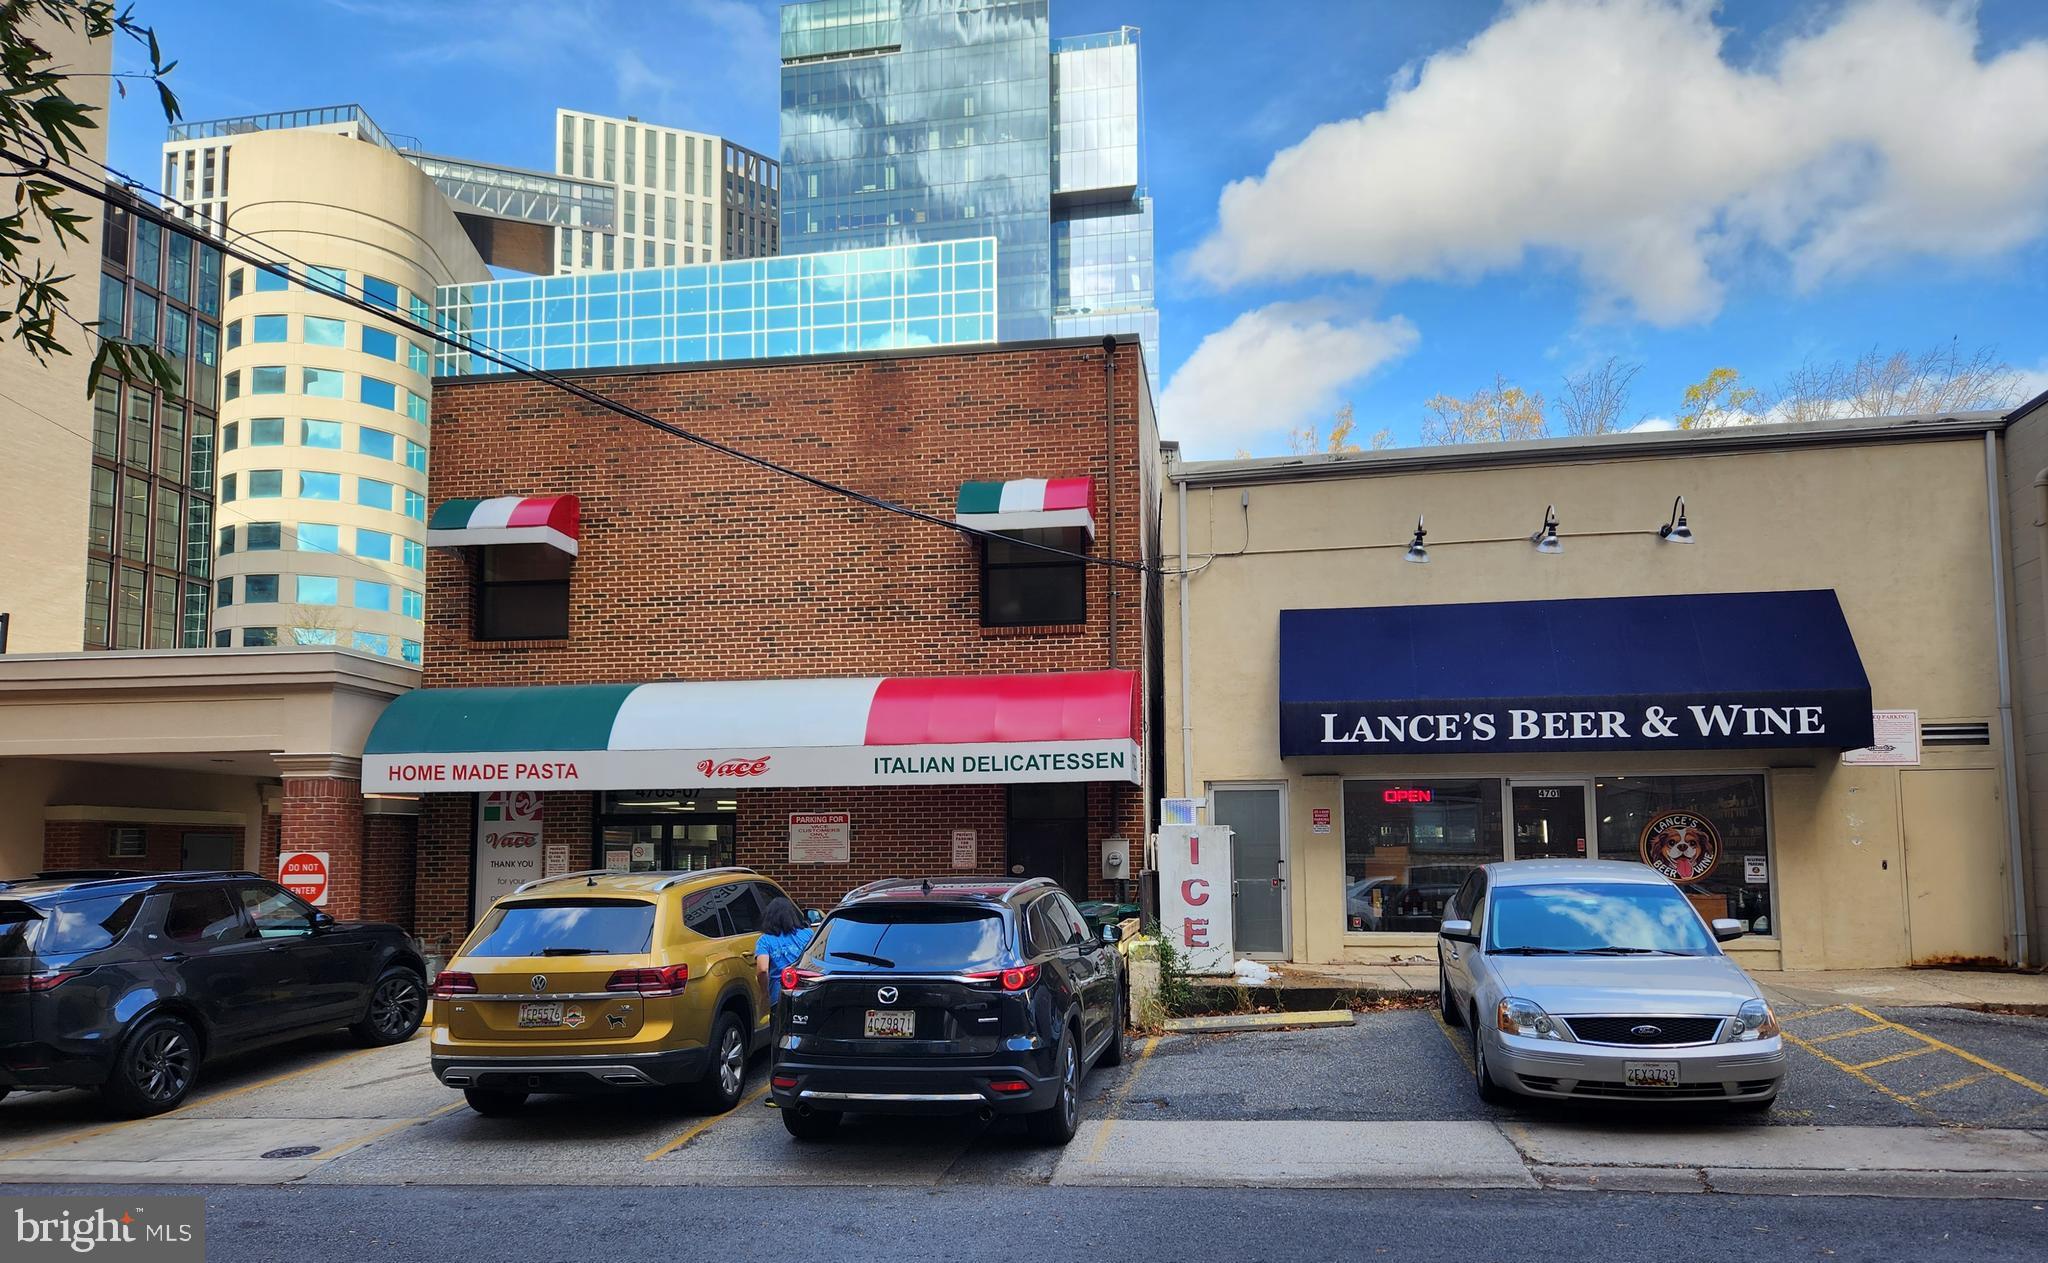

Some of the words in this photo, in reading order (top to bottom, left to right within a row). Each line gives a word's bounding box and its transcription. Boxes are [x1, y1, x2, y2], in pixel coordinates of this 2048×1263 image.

[1320, 711, 1496, 743] LANCE'S
[1508, 708, 1632, 741] BEER
[1641, 705, 1679, 738] &
[1686, 704, 1826, 737] WINE
[873, 756, 956, 774] ITALIAN
[962, 751, 1125, 773] DELICATESSEN
[388, 764, 446, 781] HOME
[452, 764, 510, 781] MADE
[515, 762, 579, 780] PASTA
[1384, 790, 1431, 803] OPEN
[796, 816, 828, 824] PARKING
[1653, 816, 1699, 834] LANCE'S
[288, 863, 300, 872] DO
[302, 863, 319, 872] NOT
[490, 860, 516, 868] THANK
[516, 860, 534, 868] YOU
[1652, 860, 1677, 878] BEER
[1693, 853, 1715, 874] WINE
[497, 877, 508, 885] for
[509, 879, 526, 887] your
[867, 1017, 911, 1033] 4CZ9871
